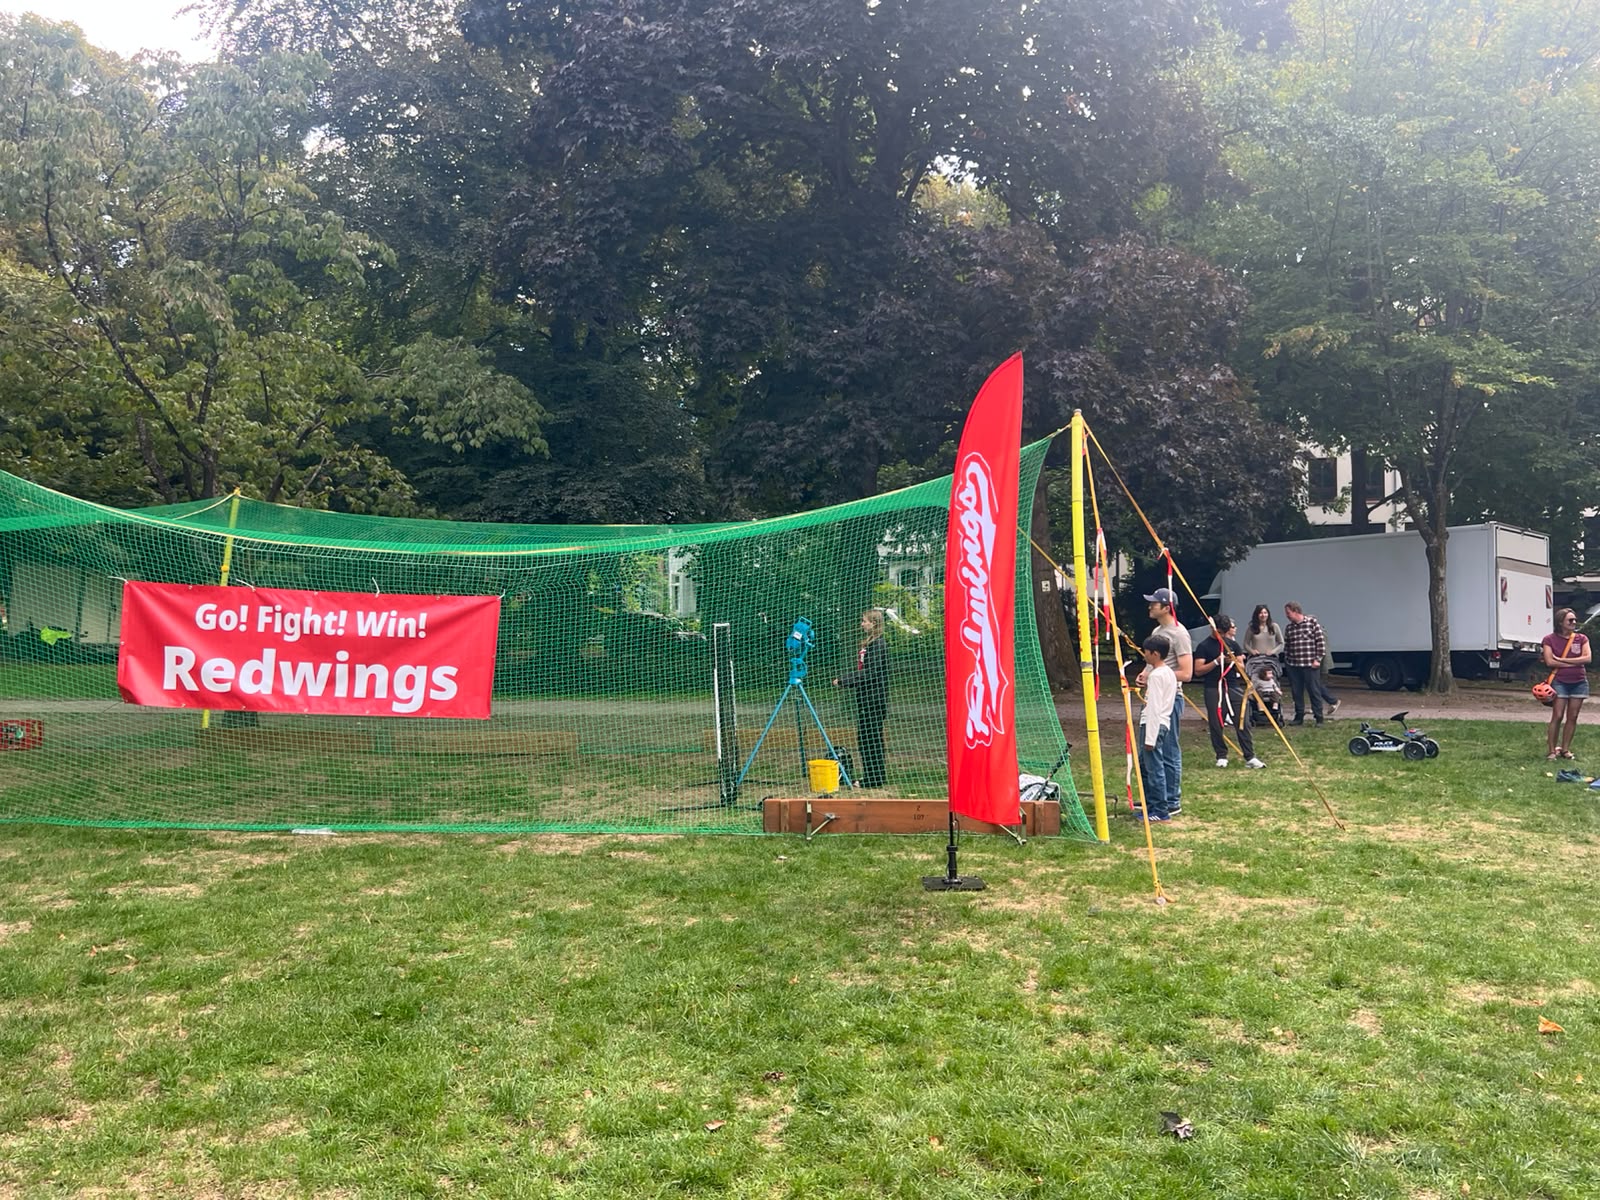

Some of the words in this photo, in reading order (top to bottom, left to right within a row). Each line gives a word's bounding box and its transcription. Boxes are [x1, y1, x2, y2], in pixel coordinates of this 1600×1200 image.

[195, 603, 248, 633] Go!
[257, 606, 348, 642] Fight!
[356, 610, 428, 637] Win!
[958, 460, 1000, 743] Rwings
[162, 645, 459, 713] Redwings
